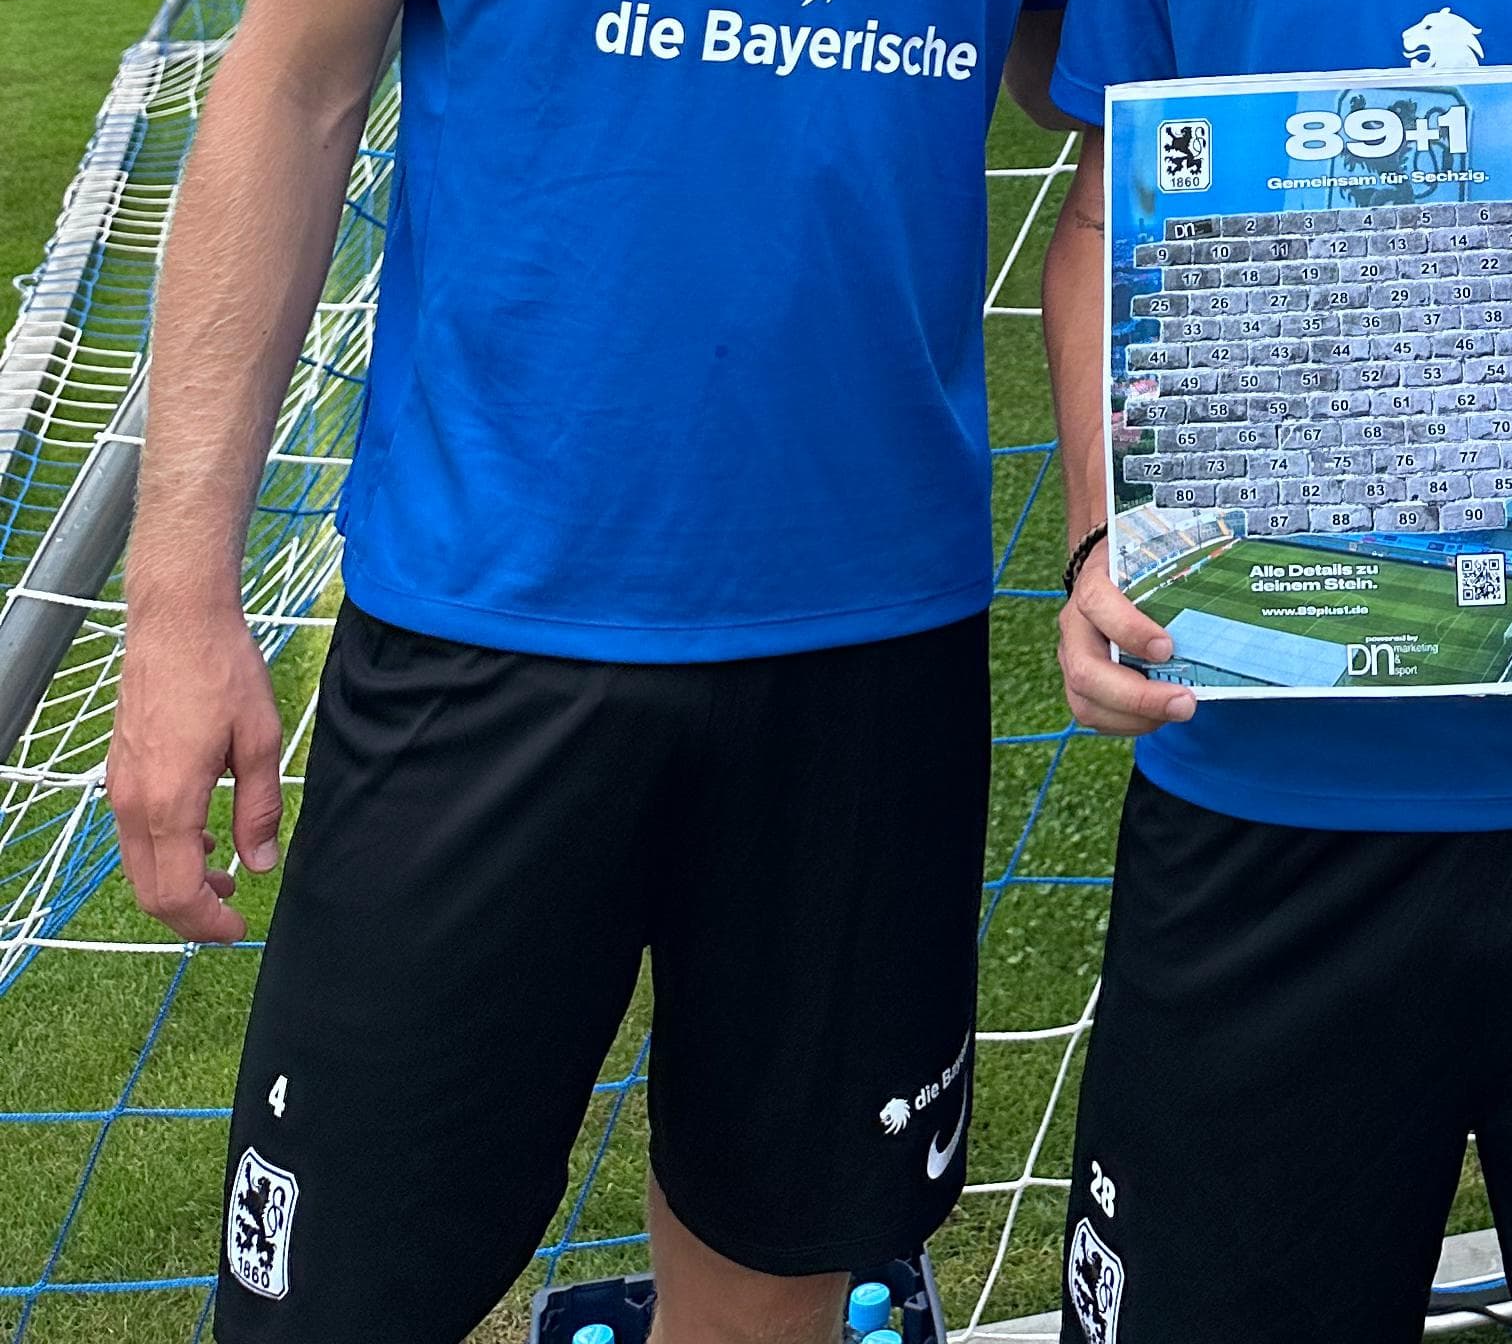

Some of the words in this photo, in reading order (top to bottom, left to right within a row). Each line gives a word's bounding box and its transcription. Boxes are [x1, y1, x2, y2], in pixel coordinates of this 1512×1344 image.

[594, 0, 686, 61] die
[701, 7, 979, 82] Bayerische
[1285, 105, 1469, 161] 89+1
[1170, 176, 1201, 188] 1860
[1266, 175, 1377, 191] Gemeinsam
[1379, 171, 1408, 186] für
[1411, 168, 1490, 185] Sechzig.
[1363, 214, 1372, 225] 4
[1422, 212, 1431, 223] 5
[1480, 209, 1489, 221] 6
[1247, 220, 1255, 232] 2
[1305, 217, 1313, 229] 3
[1389, 238, 1406, 250] 13
[1450, 234, 1468, 247] 14
[1212, 246, 1229, 258] 10
[1271, 244, 1287, 256] 11
[1330, 241, 1347, 253] 12
[1158, 249, 1167, 261] 9
[1421, 262, 1437, 275] 21
[1481, 258, 1499, 270] 22
[1242, 270, 1258, 282] 18
[1302, 268, 1319, 279] 19
[1361, 265, 1378, 277] 20
[1183, 273, 1203, 286] 17
[1331, 292, 1348, 304] 28
[1391, 290, 1409, 302] 29
[1454, 287, 1471, 299] 30
[1151, 300, 1169, 312] 25
[1211, 297, 1229, 309] 26
[1270, 295, 1288, 307] 27
[1362, 316, 1380, 328] 36
[1423, 313, 1441, 325] 37
[1485, 310, 1502, 323] 38
[1184, 323, 1202, 336] 33
[1243, 321, 1260, 333] 34
[1303, 318, 1320, 331] 35
[1332, 344, 1350, 357] 44
[1393, 342, 1412, 354] 45
[1455, 338, 1474, 351] 46
[1149, 351, 1166, 363] 41
[1211, 349, 1229, 361] 42
[1271, 347, 1289, 359] 43
[1362, 370, 1380, 382] 52
[1424, 367, 1442, 380] 53
[1487, 364, 1505, 376] 54
[1181, 377, 1198, 389] 49
[1241, 375, 1258, 387] 50
[1302, 373, 1318, 385] 51
[1331, 399, 1349, 412] 60
[1393, 396, 1409, 409] 61
[1457, 394, 1476, 406] 62
[1149, 406, 1168, 419] 57
[1210, 404, 1228, 416] 58
[1269, 402, 1287, 415] 59
[1364, 426, 1382, 439] 68
[1428, 423, 1446, 435] 69
[1492, 421, 1510, 433] 70
[1178, 433, 1196, 445] 65
[1239, 430, 1257, 443] 66
[1303, 429, 1322, 441] 67
[1333, 456, 1351, 468] 75
[1396, 454, 1414, 467] 76
[1459, 451, 1477, 463] 77
[1143, 464, 1162, 476] 72
[1207, 460, 1225, 472] 73
[1271, 458, 1288, 471] 74
[1429, 481, 1448, 493] 84
[1495, 478, 1512, 490] 85
[1176, 489, 1194, 501] 80
[1240, 488, 1256, 500] 81
[1302, 485, 1320, 497] 82
[1367, 484, 1385, 497] 83
[1332, 513, 1350, 526] 88
[1399, 512, 1417, 525] 89
[1465, 508, 1483, 521] 90
[1270, 516, 1289, 528] 87
[1249, 564, 1286, 578] Alle
[1288, 563, 1353, 577] Details
[1355, 564, 1379, 576] zu
[1250, 578, 1322, 593] deinem
[1323, 577, 1379, 591] Stein.
[1261, 605, 1370, 618] www.89plus1.de
[1365, 635, 1405, 644] powered
[1406, 634, 1419, 644] by
[1394, 643, 1439, 654] marketing
[1394, 665, 1418, 677] sport
[267, 1074, 289, 1118] 4
[914, 1083, 940, 1110] die
[1089, 1160, 1117, 1218] 28
[236, 1256, 271, 1290] 1860
